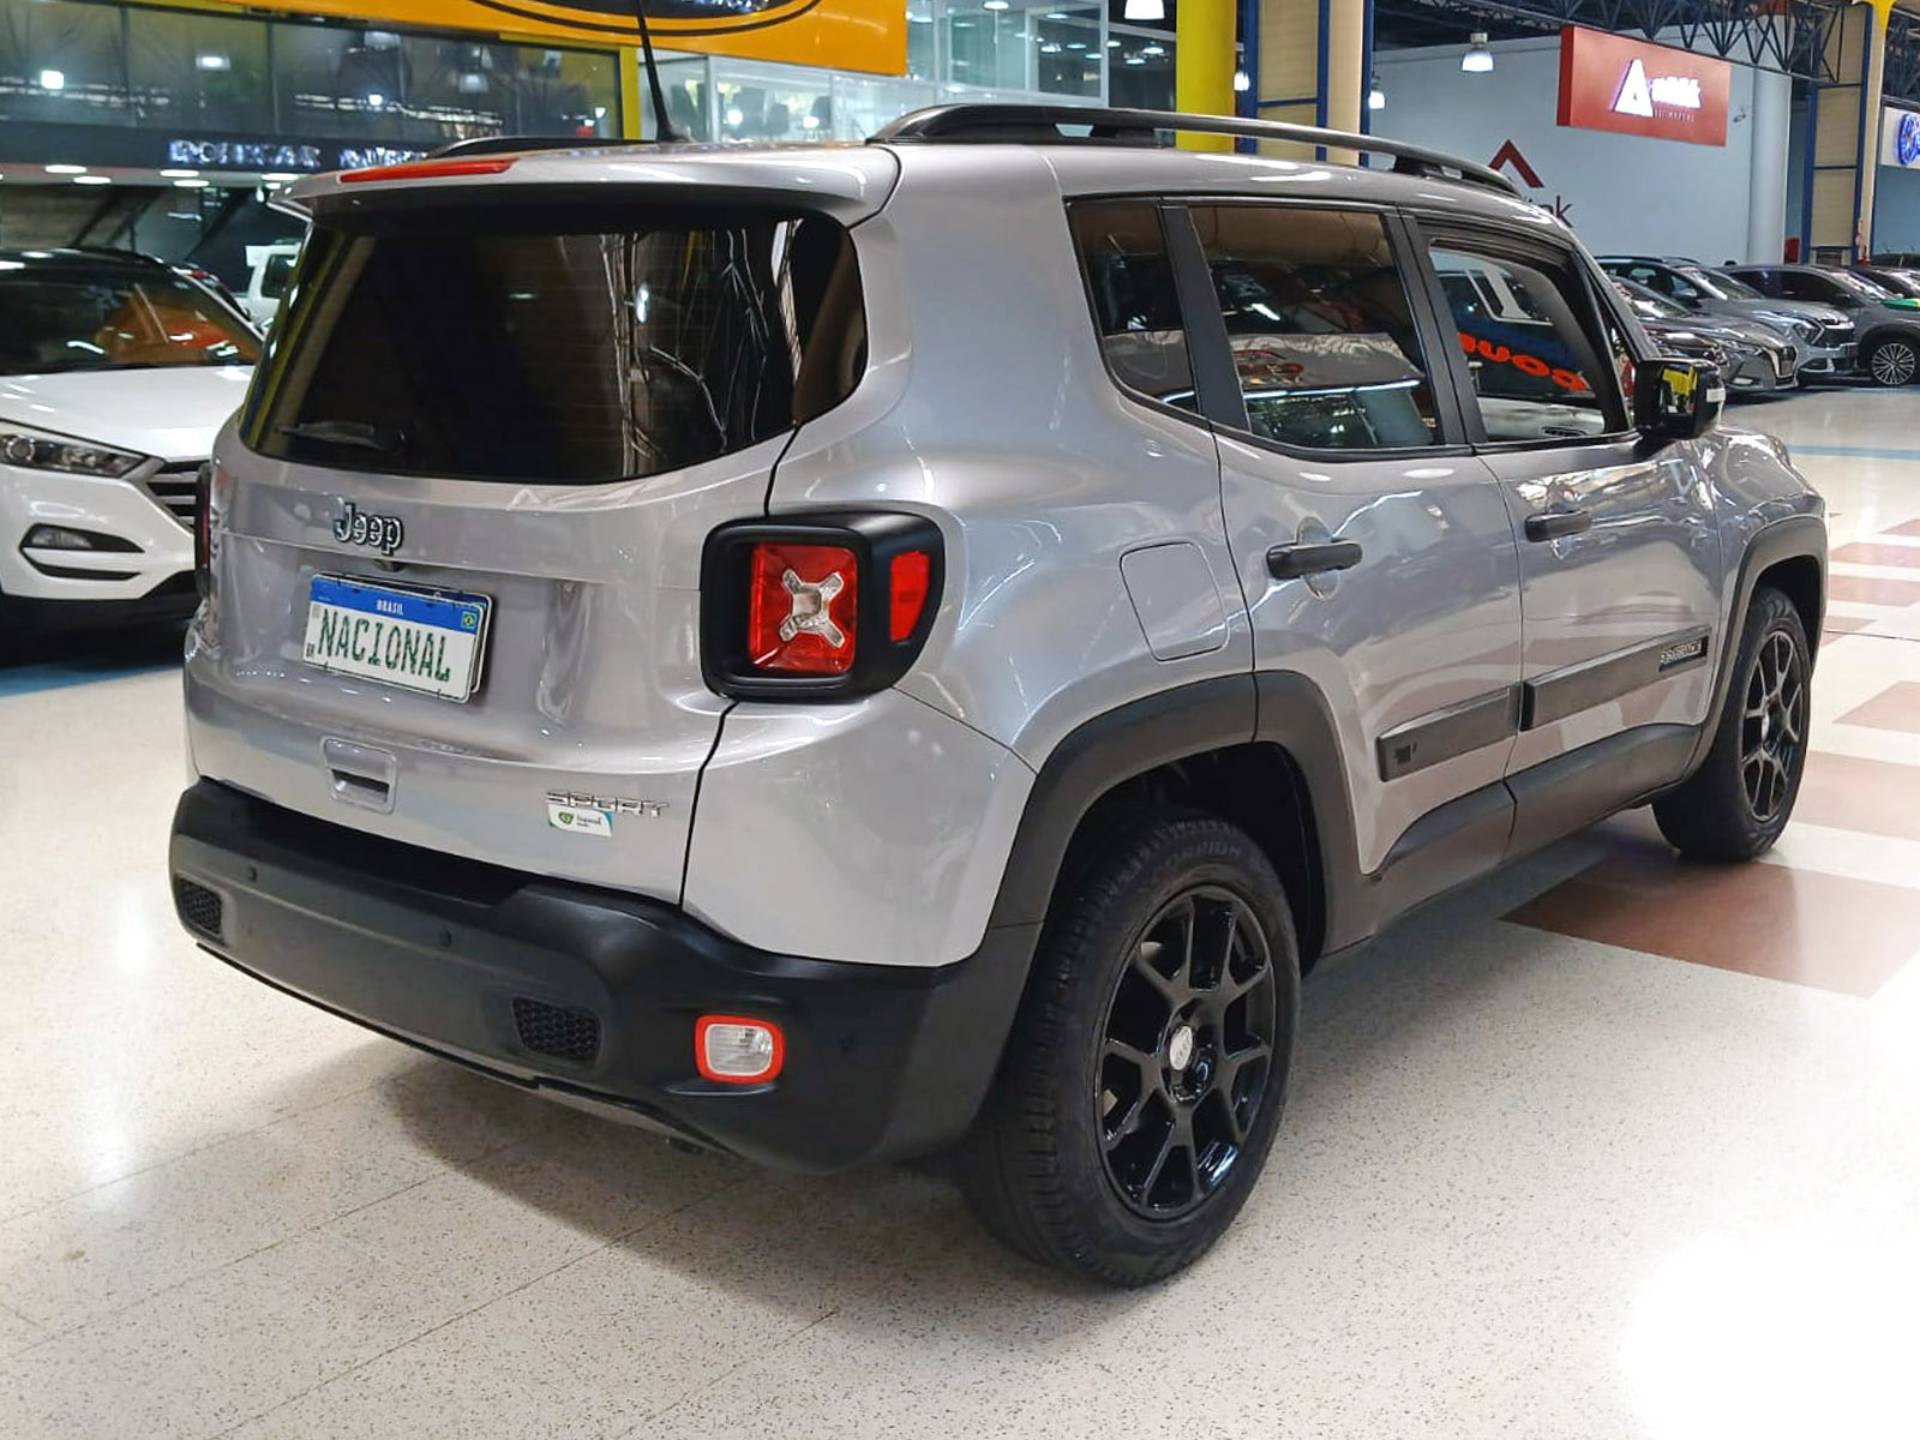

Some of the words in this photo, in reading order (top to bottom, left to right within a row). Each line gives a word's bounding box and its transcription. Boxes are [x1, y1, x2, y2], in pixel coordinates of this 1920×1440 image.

[333, 497, 404, 556] Jeep
[375, 599, 404, 617] BRASIL
[317, 608, 452, 683] NACIONAL
[546, 789, 671, 817] SPORT
